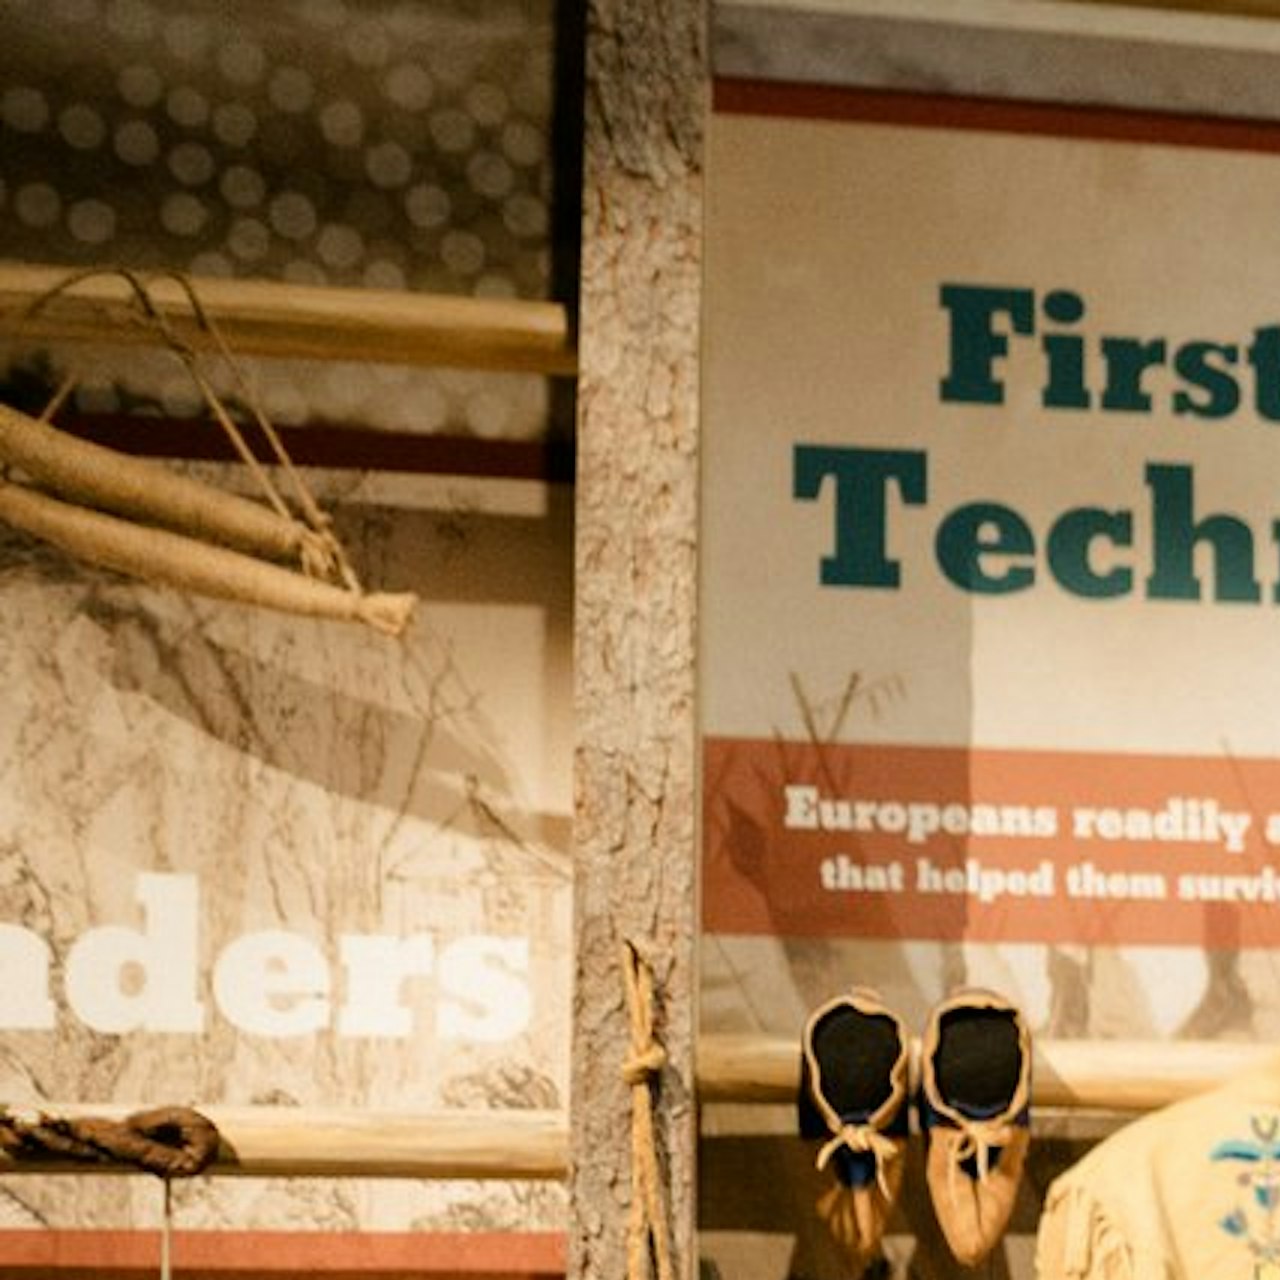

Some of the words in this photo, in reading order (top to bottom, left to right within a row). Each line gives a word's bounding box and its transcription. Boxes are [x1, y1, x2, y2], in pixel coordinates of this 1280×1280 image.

[784, 784, 1058, 843] Europeans
[1072, 797, 1251, 853] readily
[820, 855, 904, 893] that
[916, 858, 1055, 902] helped
[1066, 862, 1165, 900] them
